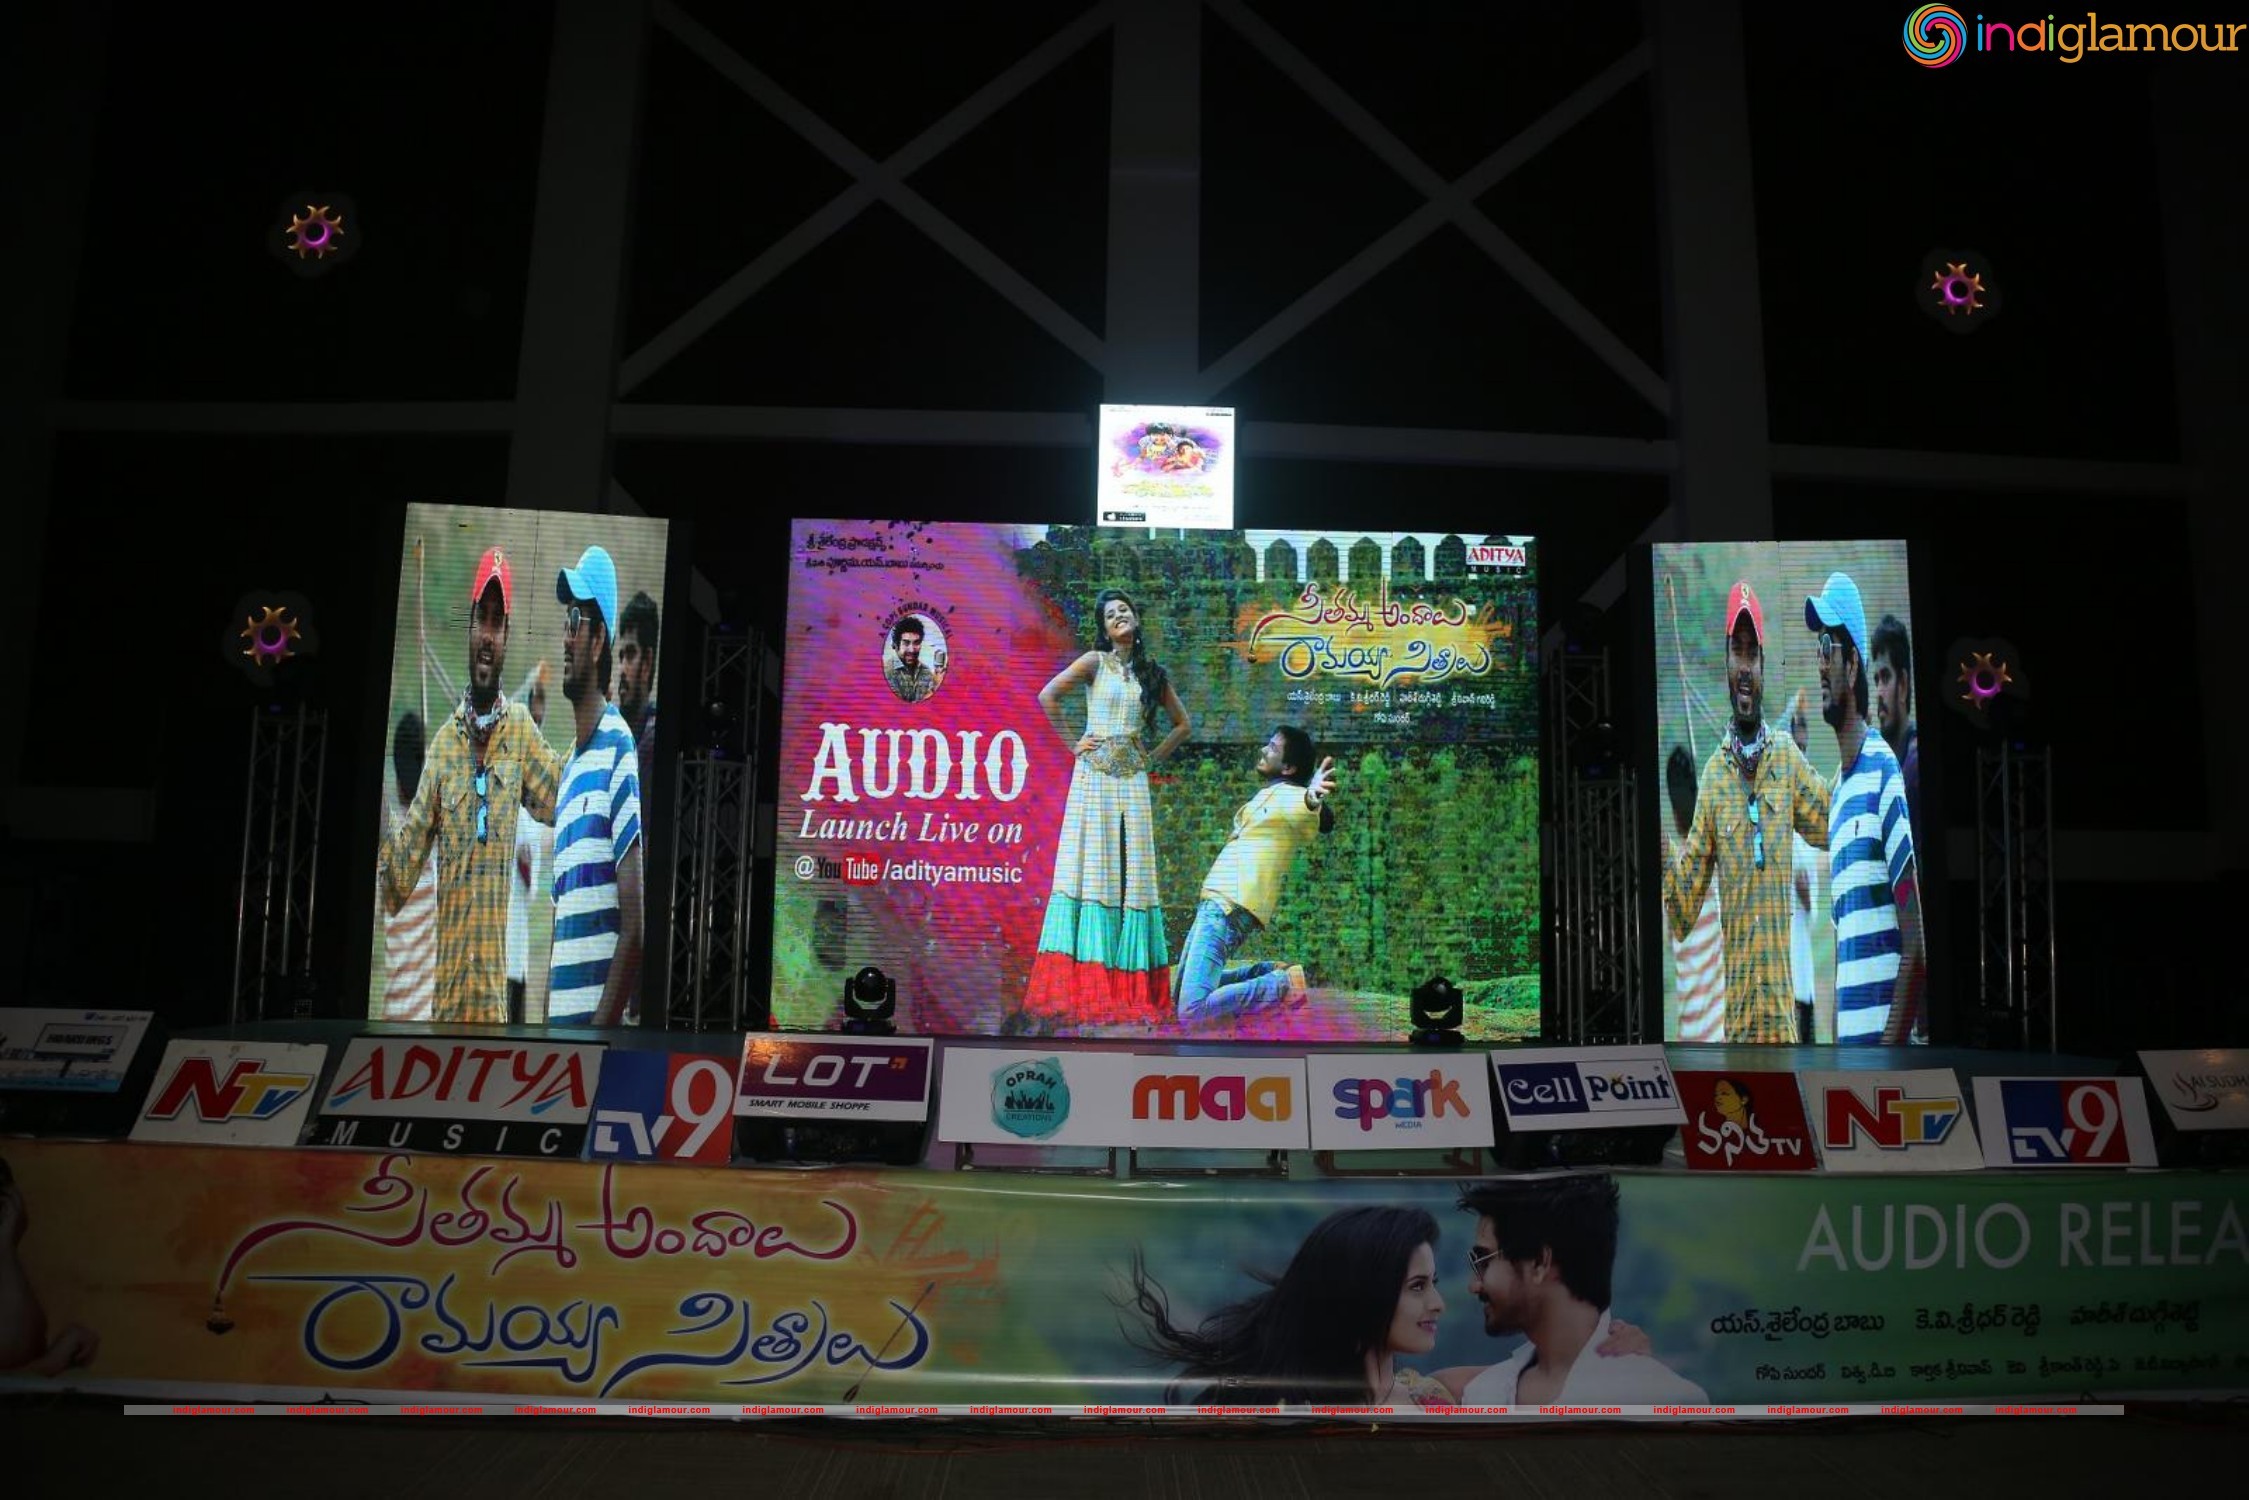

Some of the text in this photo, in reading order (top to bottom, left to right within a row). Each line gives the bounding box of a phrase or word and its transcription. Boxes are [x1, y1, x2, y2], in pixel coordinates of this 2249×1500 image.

[1469, 547, 1524, 562] ADITYA
[800, 722, 1029, 802] AUDIO
[799, 808, 1023, 845] Launch Live on
[145, 1057, 311, 1122] NTV
[334, 1046, 588, 1108] ADITYA
[763, 1053, 891, 1088] LOT
[1132, 1073, 1292, 1121] maa
[1334, 1068, 1471, 1132] spark
[1507, 1073, 1671, 1105] Cell Point
[594, 1058, 734, 1157] TV9
[748, 1099, 871, 1111] SMART MOBILE SHOPPE
[1824, 1087, 1961, 1149] NTV
[2010, 1085, 2121, 1164] TV9
[330, 1123, 564, 1155] MUSIC
[578, 1162, 857, 1260] అందాలు
[1797, 1203, 2031, 1273] AUDIO
[1833, 1314, 1885, 1332] బాబు
